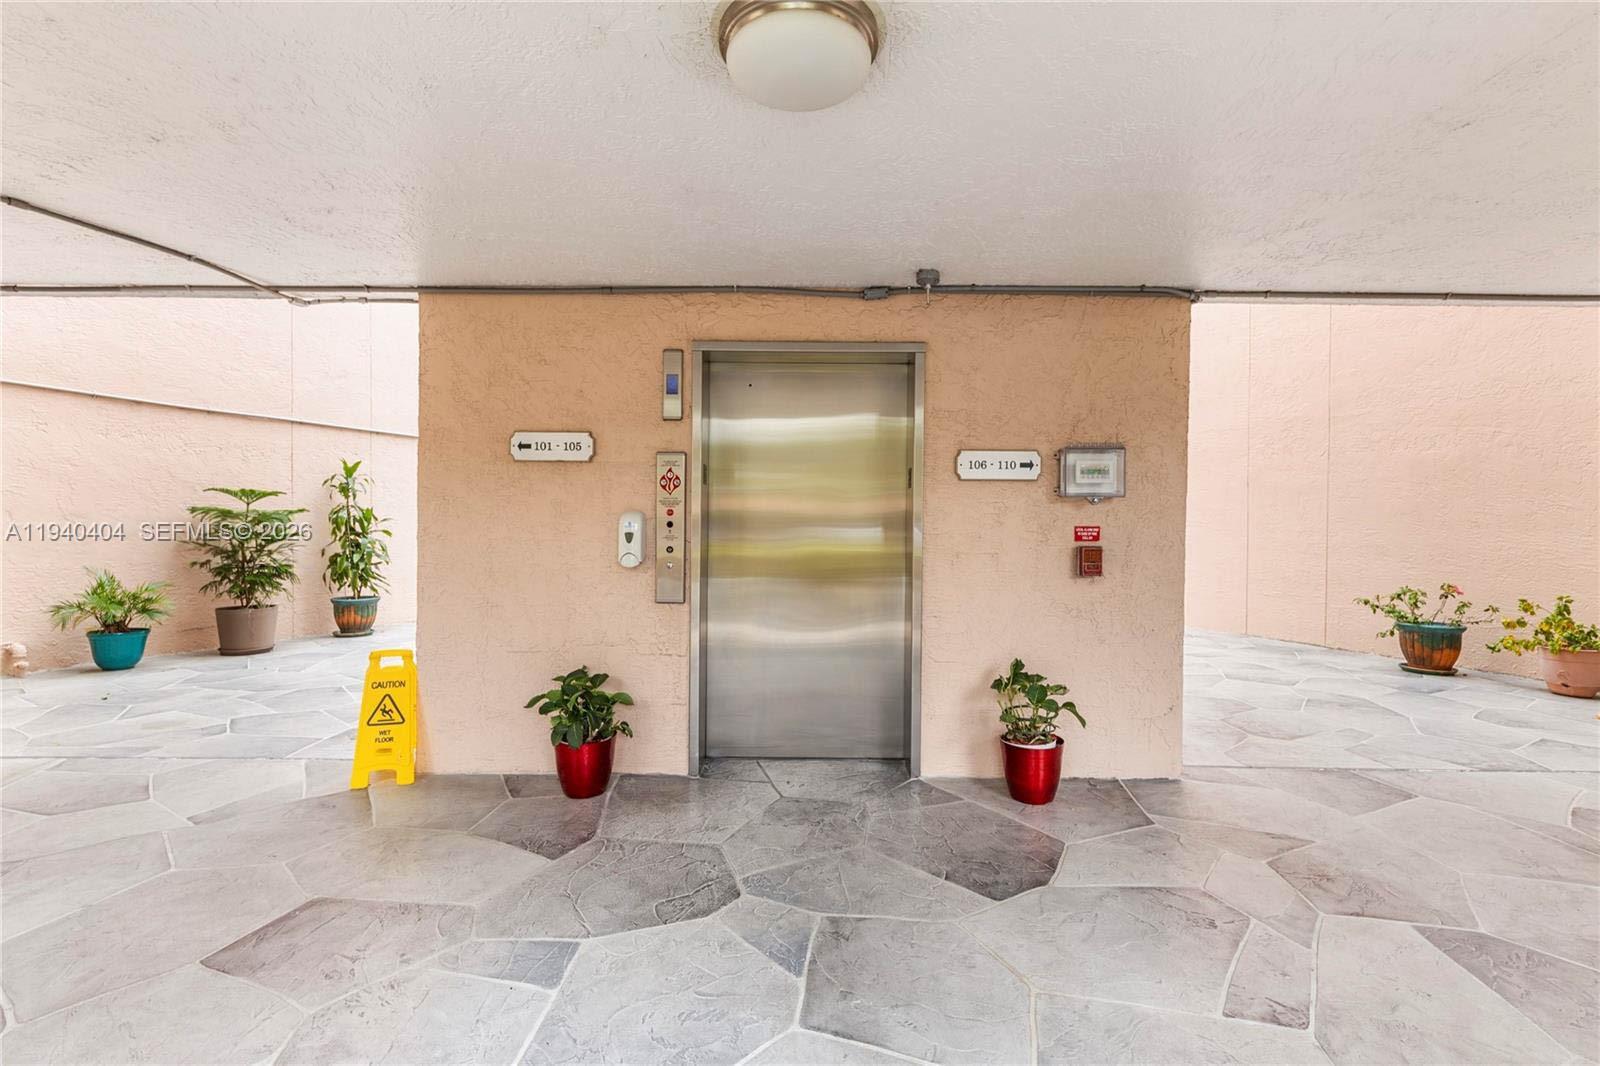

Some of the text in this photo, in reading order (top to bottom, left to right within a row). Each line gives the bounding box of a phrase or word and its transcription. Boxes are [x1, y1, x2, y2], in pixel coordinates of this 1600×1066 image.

[534, 441, 552, 451] 101
[563, 441, 582, 451] 105
[968, 460, 987, 470] 106
[998, 460, 1017, 470] 110
[371, 680, 406, 690] CAUTION
[374, 736, 394, 744] FLOOR
